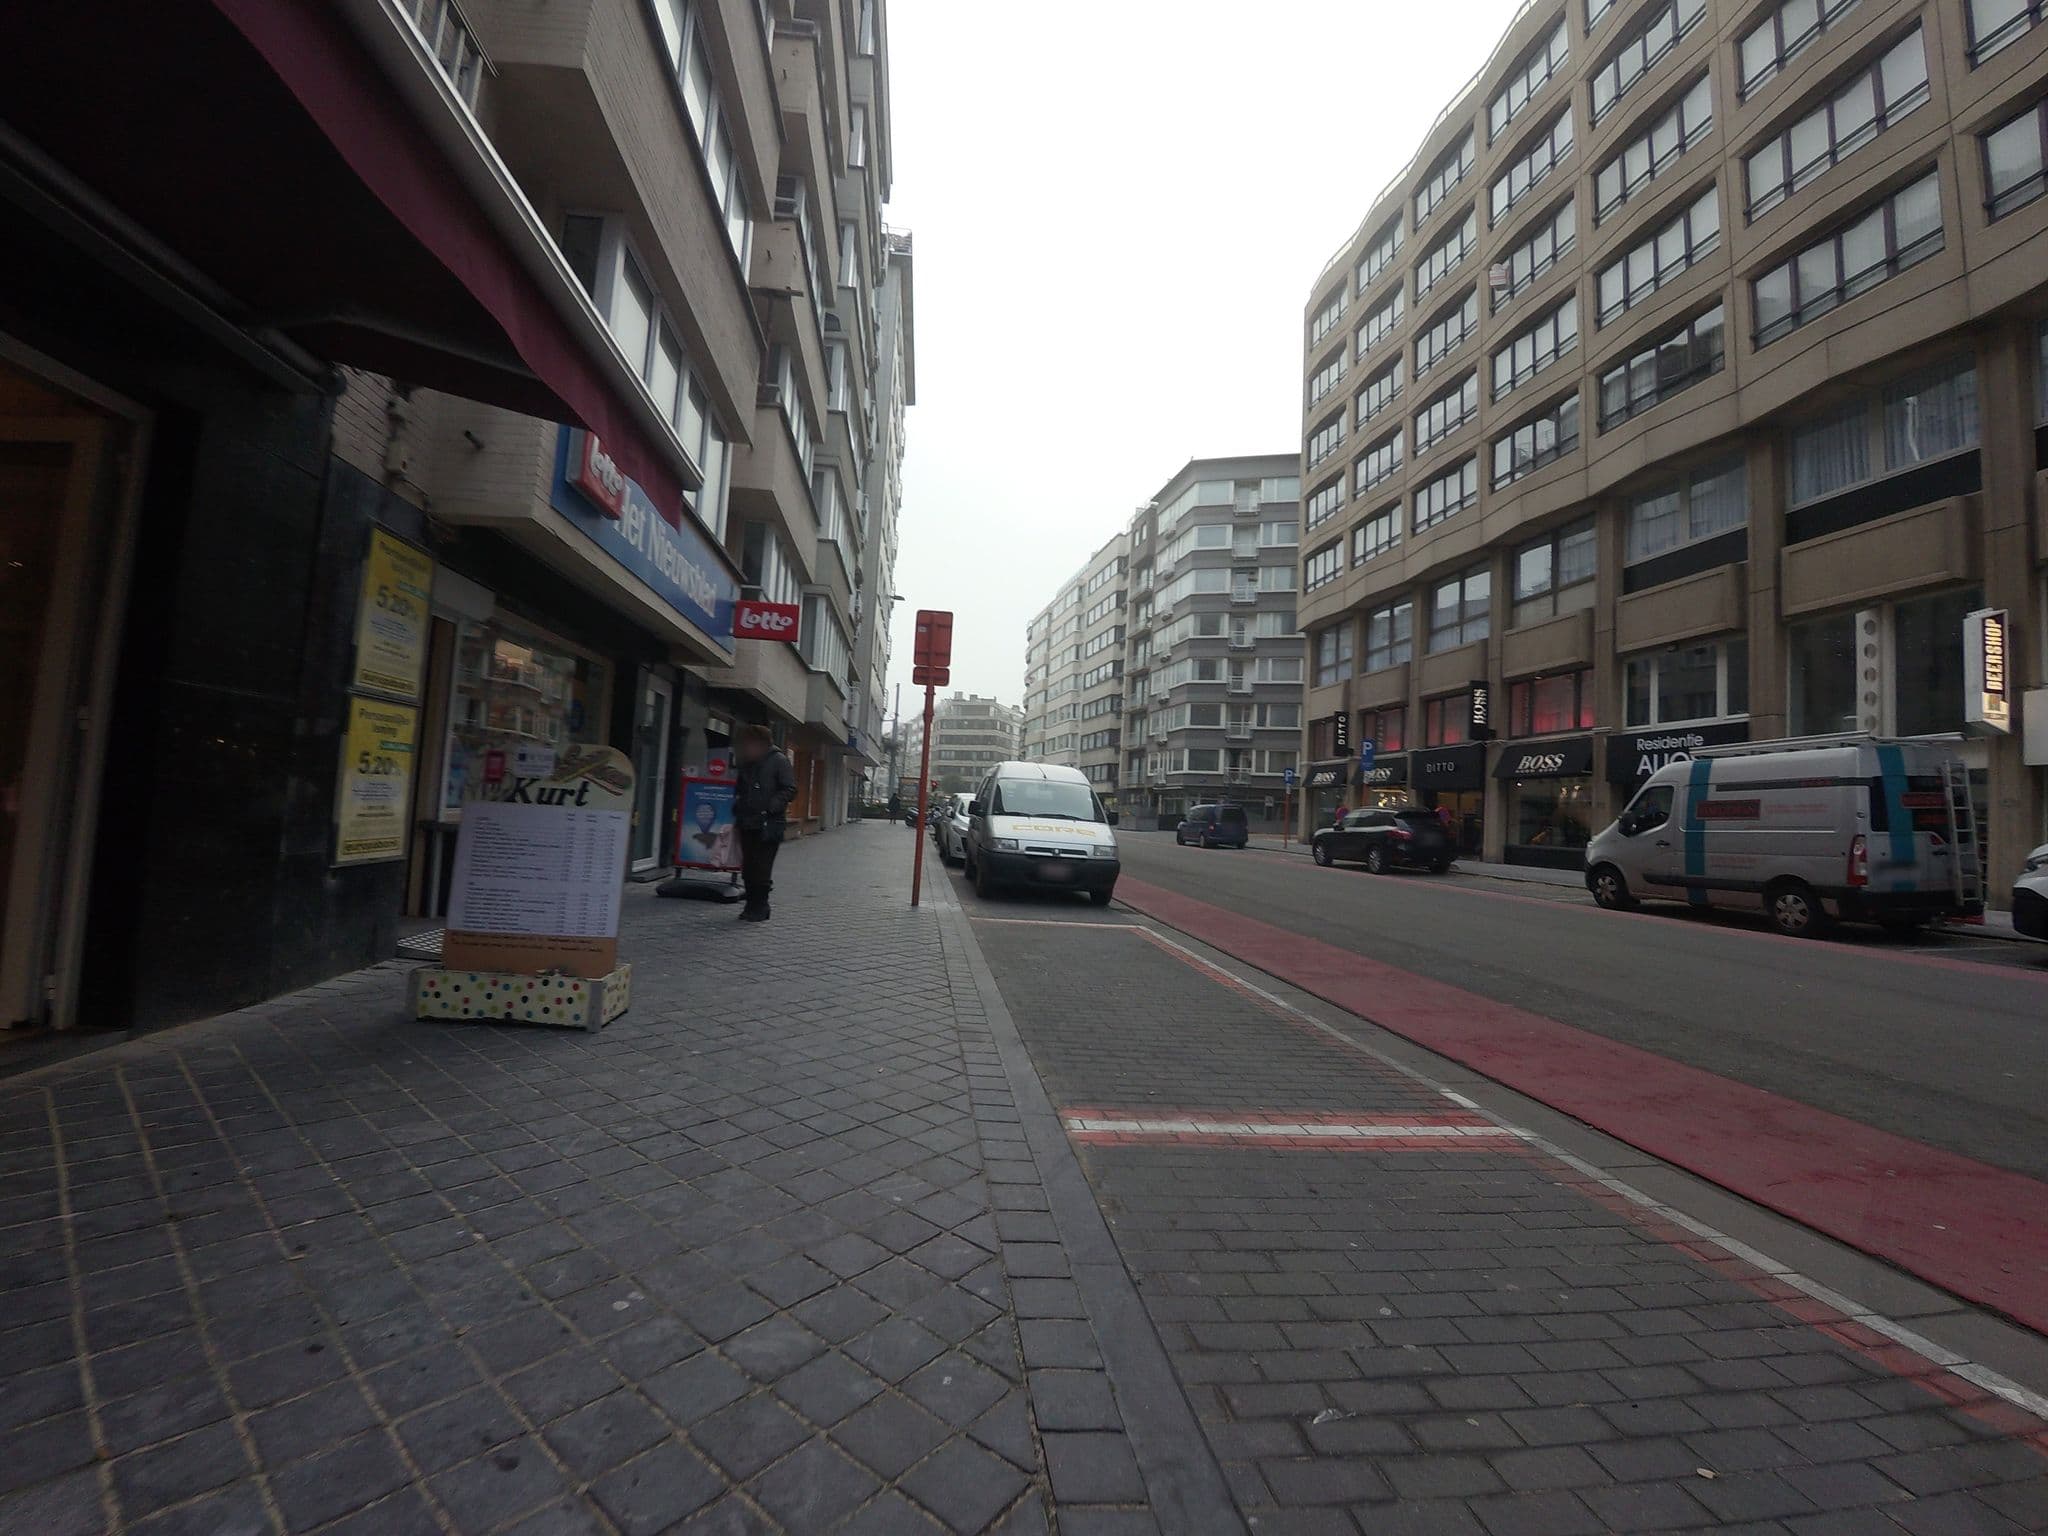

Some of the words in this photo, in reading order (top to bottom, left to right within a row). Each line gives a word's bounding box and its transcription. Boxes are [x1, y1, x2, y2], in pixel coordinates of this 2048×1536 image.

[1338, 715, 1346, 746] DITTO
[1362, 741, 1373, 756] P
[1636, 733, 1704, 751] Residentie
[1426, 761, 1455, 773] DITTO
[1517, 753, 1566, 770] BOSS
[1285, 769, 1293, 781] P
[506, 777, 590, 807] Kurt
